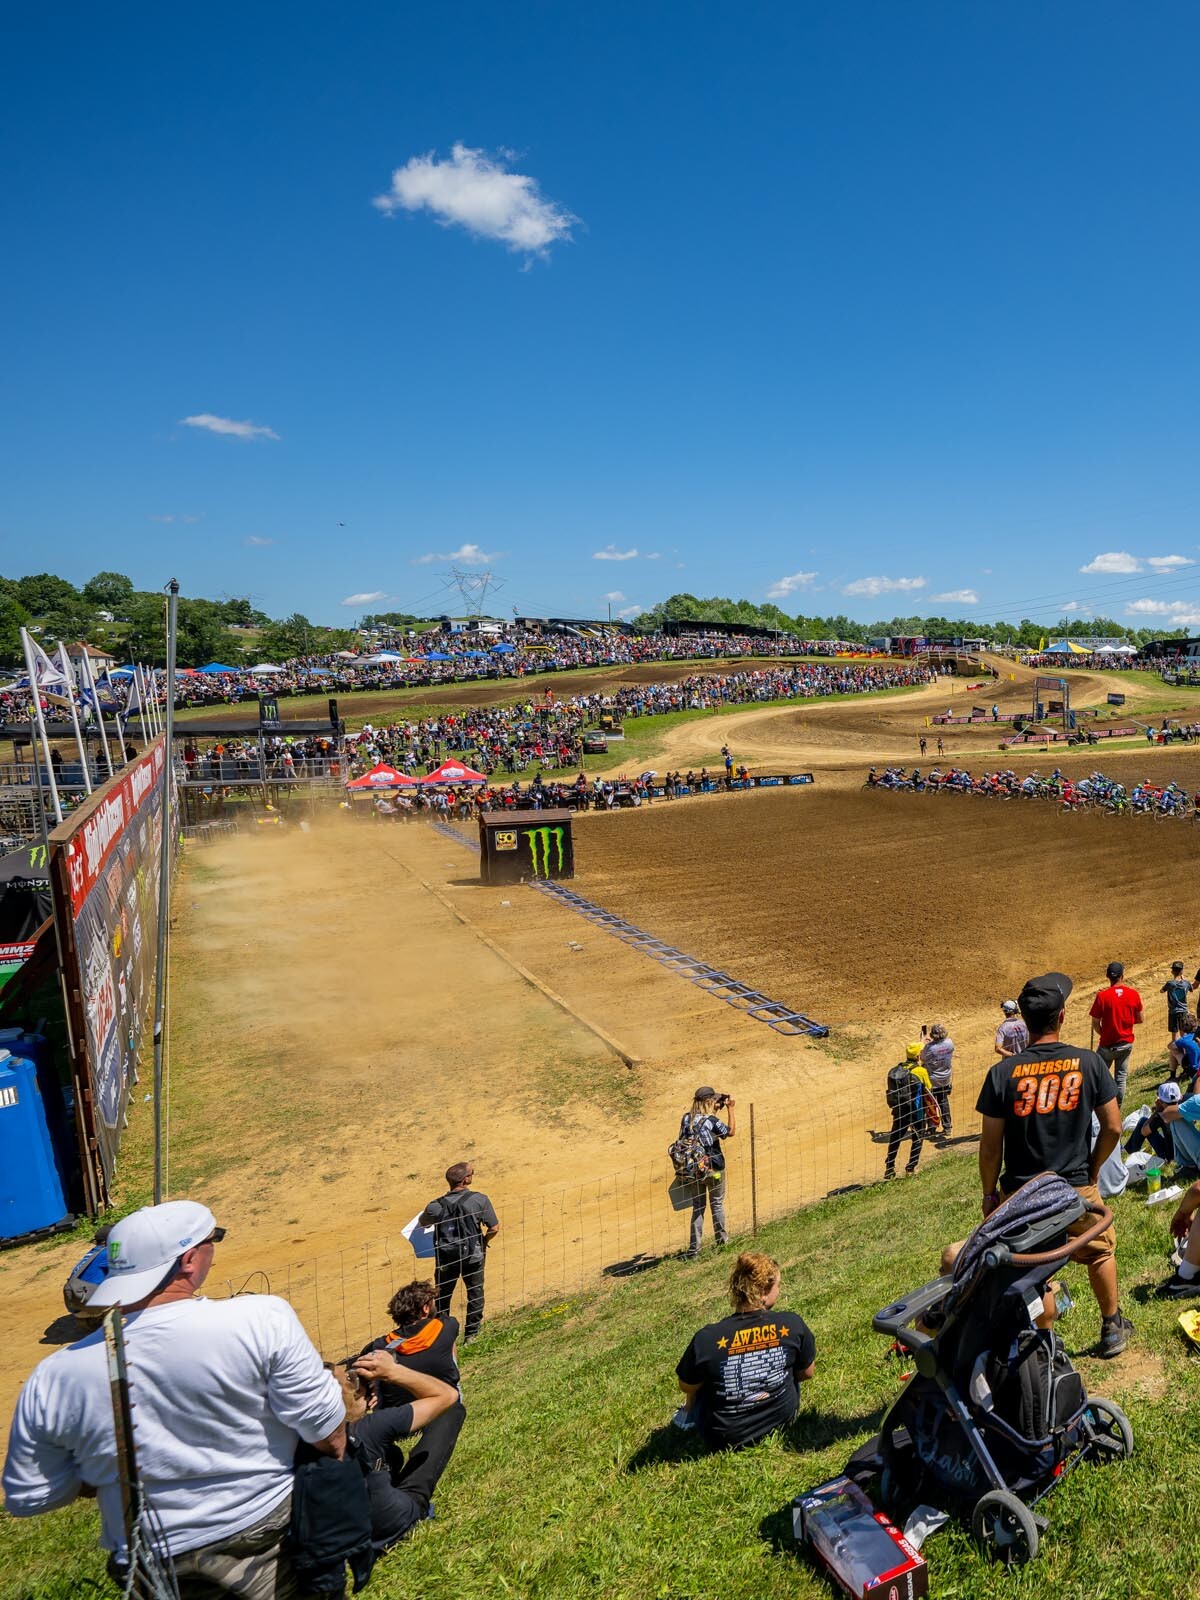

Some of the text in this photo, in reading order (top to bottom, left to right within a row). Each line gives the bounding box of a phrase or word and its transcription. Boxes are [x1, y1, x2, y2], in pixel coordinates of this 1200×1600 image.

[6, 879, 50, 889] MONST
[1012, 1058, 1080, 1078] ANDERSON
[1013, 1071, 1083, 1117] 308
[731, 1324, 777, 1348] AWRCS
[906, 1572, 914, 1600] ASGAS
